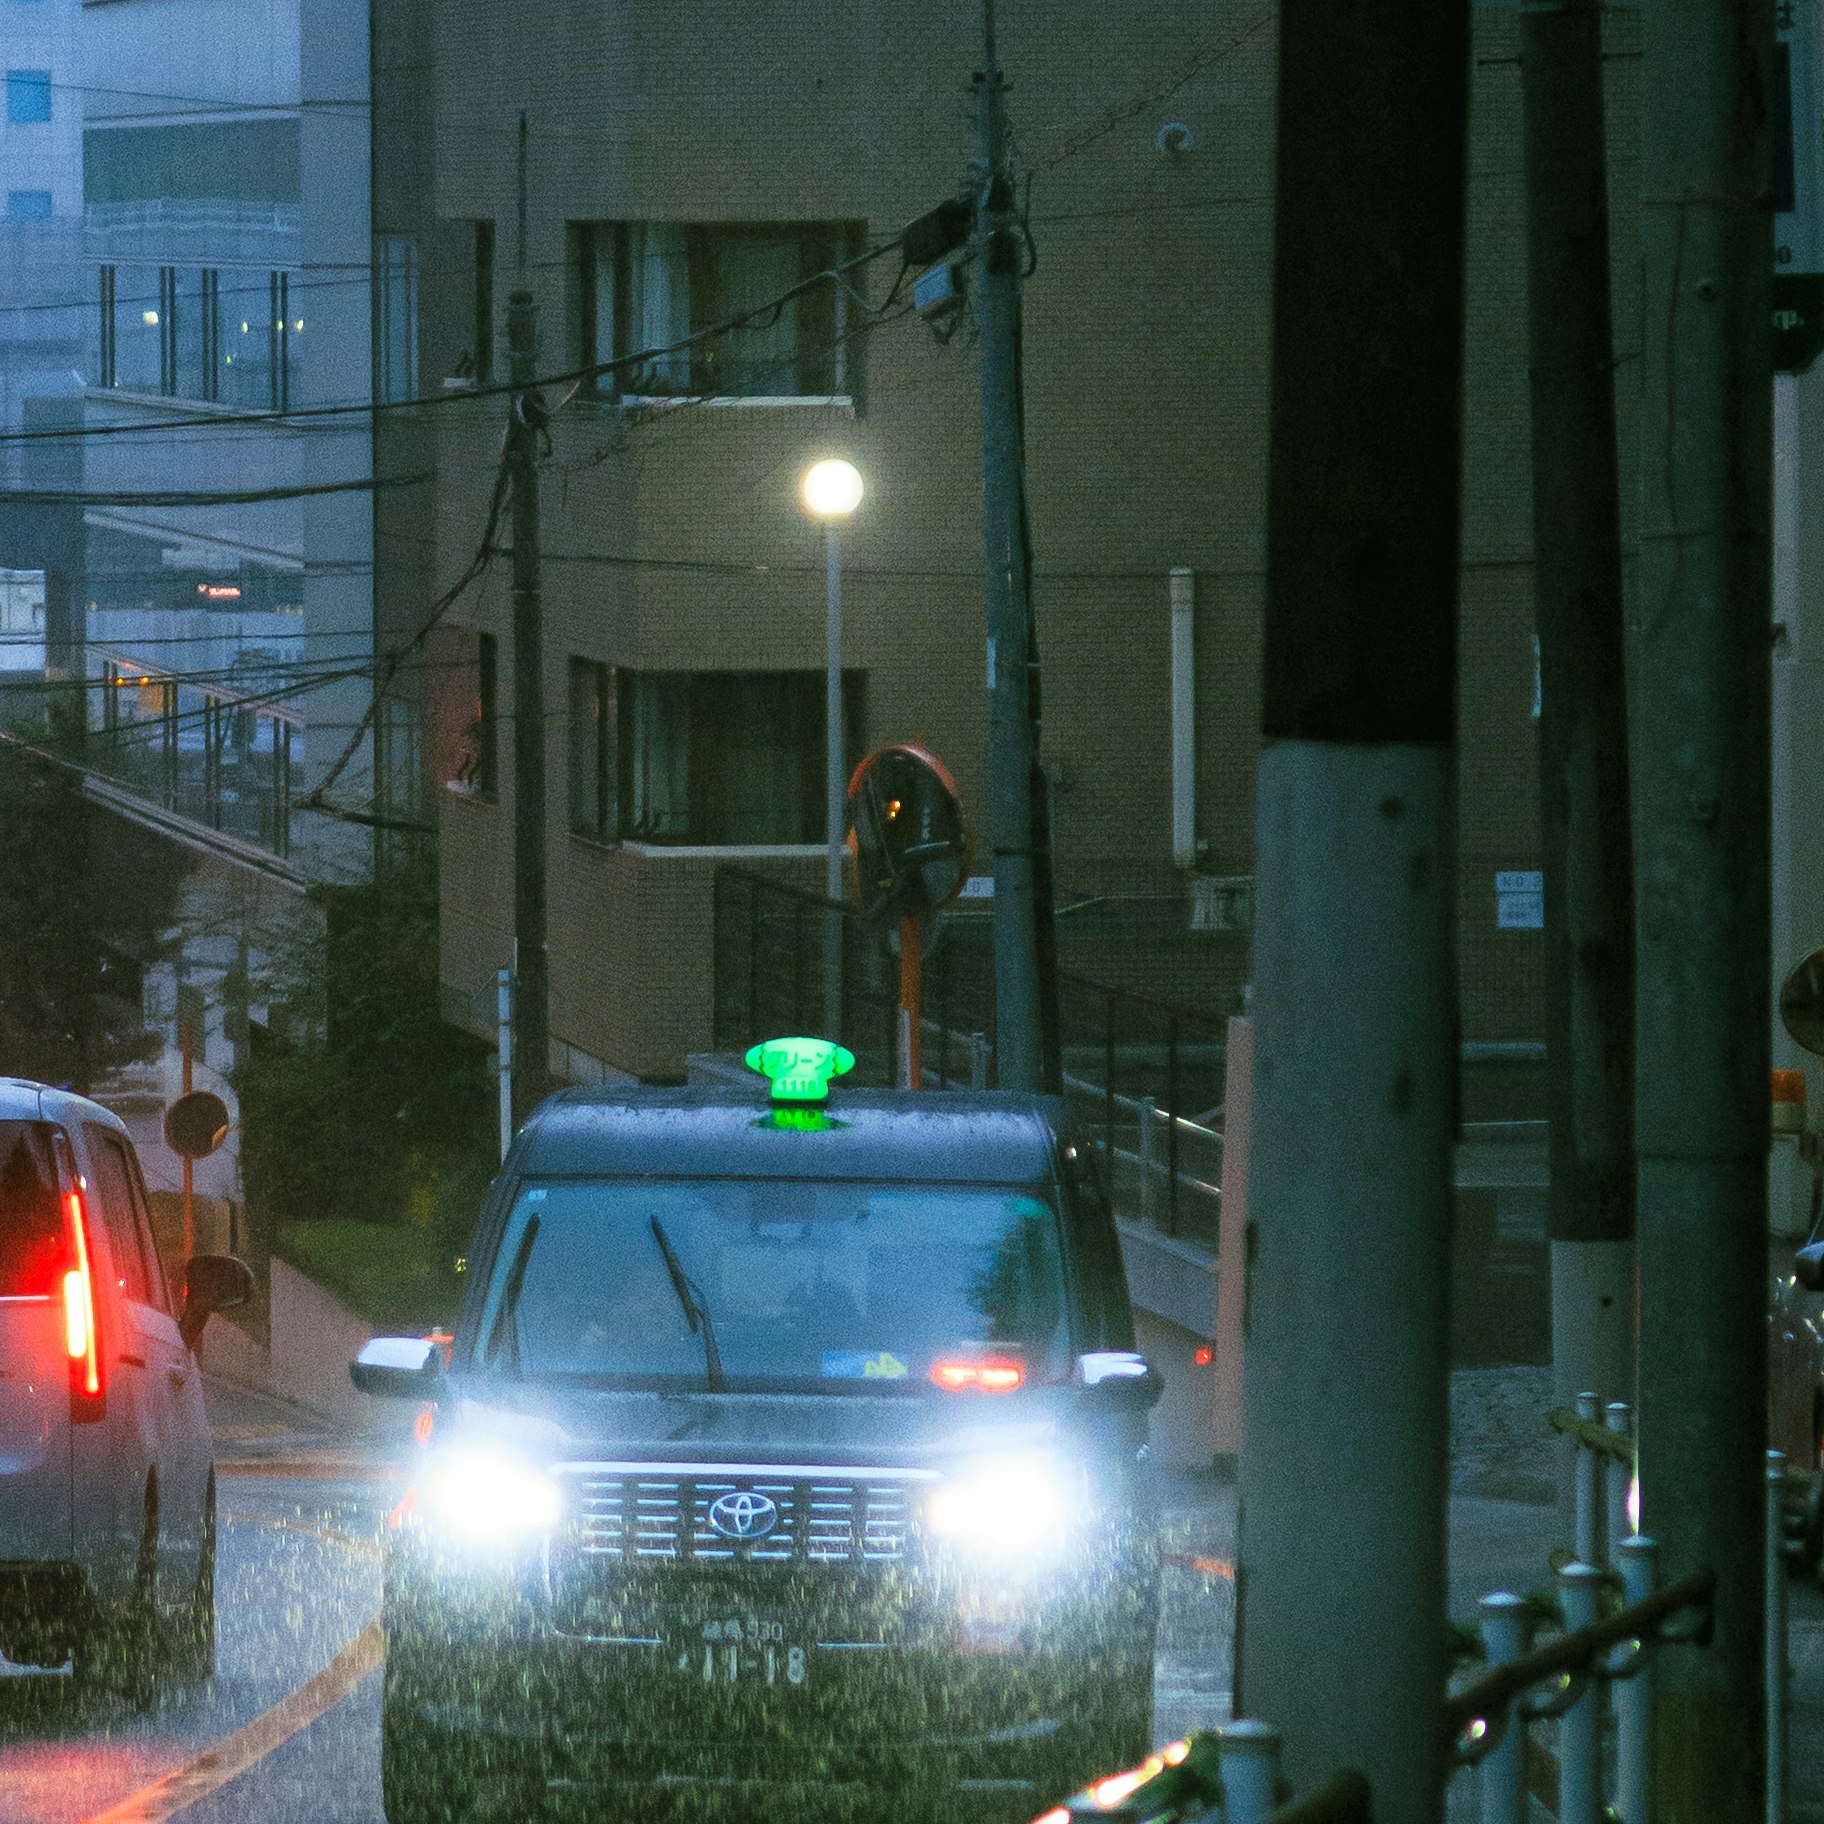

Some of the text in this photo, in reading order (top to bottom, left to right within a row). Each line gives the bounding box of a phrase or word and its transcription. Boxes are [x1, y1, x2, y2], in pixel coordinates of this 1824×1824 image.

[767, 1050, 831, 1071] グリーン
[780, 1079, 817, 1093] 1118
